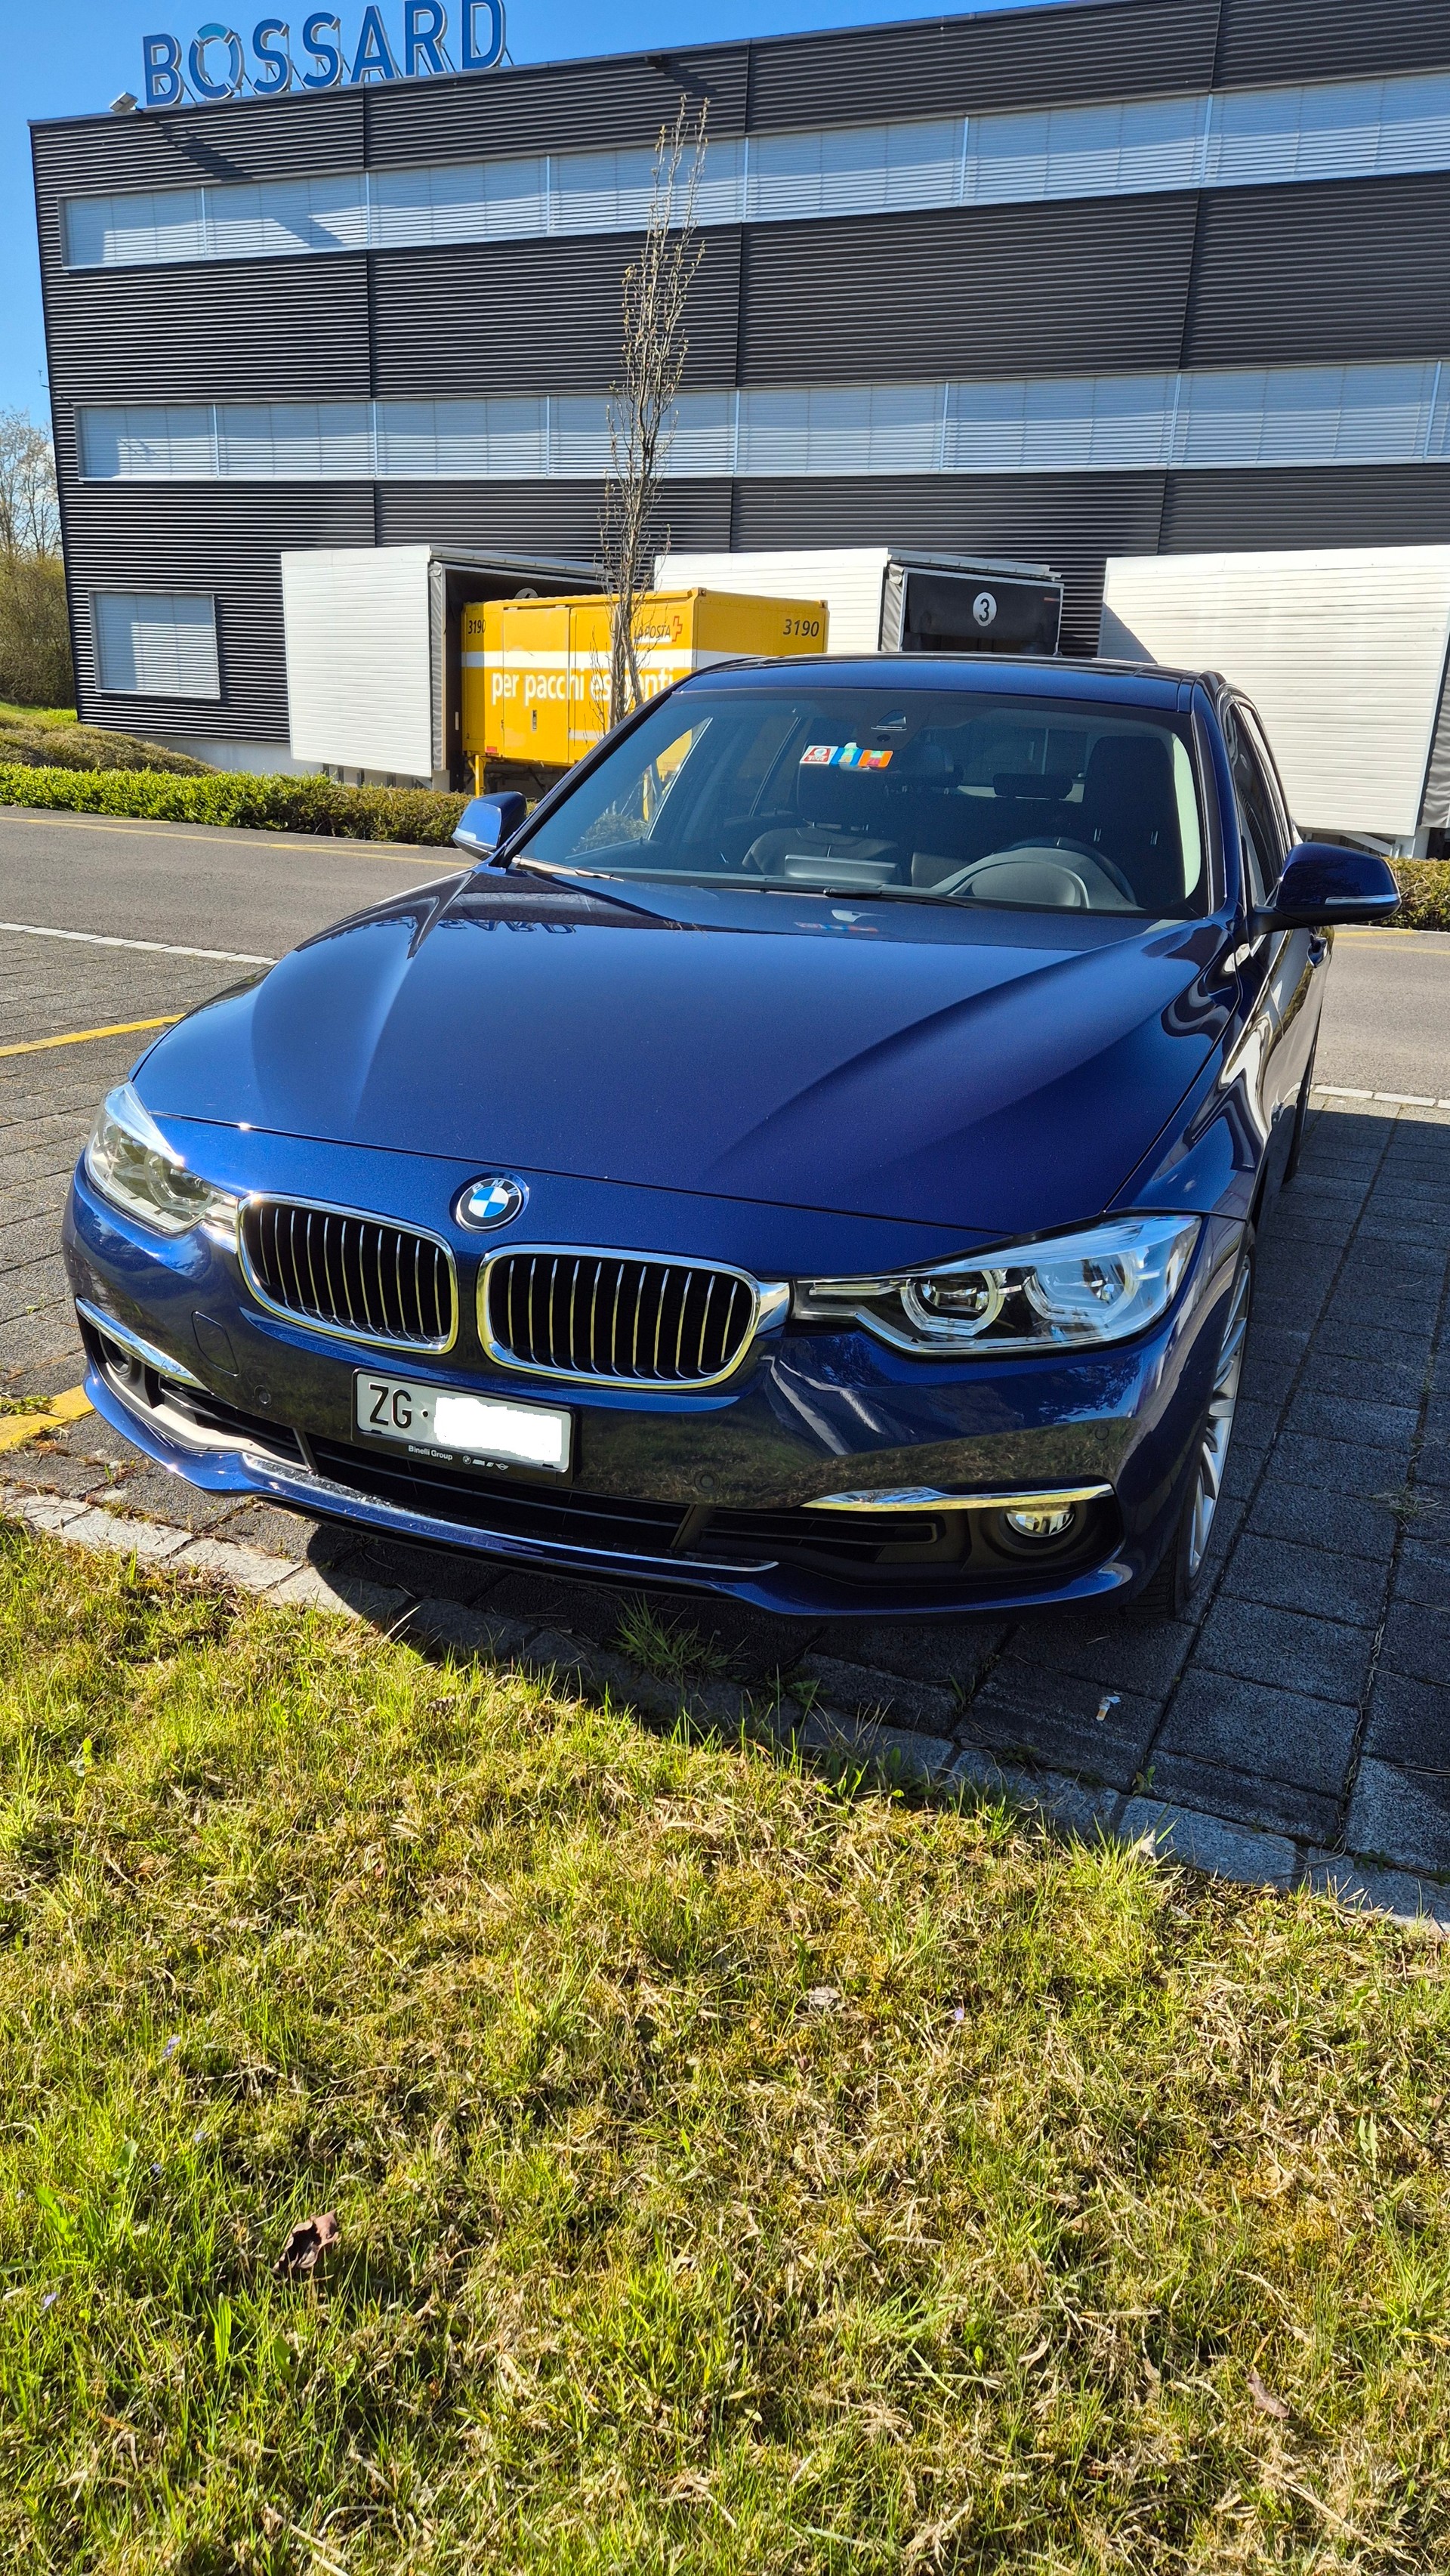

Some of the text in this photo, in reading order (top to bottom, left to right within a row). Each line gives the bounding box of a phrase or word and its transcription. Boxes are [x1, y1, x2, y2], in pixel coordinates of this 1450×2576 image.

[143, 0, 507, 107] BOSSARD
[978, 598, 990, 622] 3
[468, 619, 486, 635] 3190
[644, 624, 671, 639] POSTA
[783, 619, 819, 637] 3190
[492, 672, 520, 706] per
[525, 666, 585, 706] pacchi
[408, 1444, 453, 1461] Binelli Group
